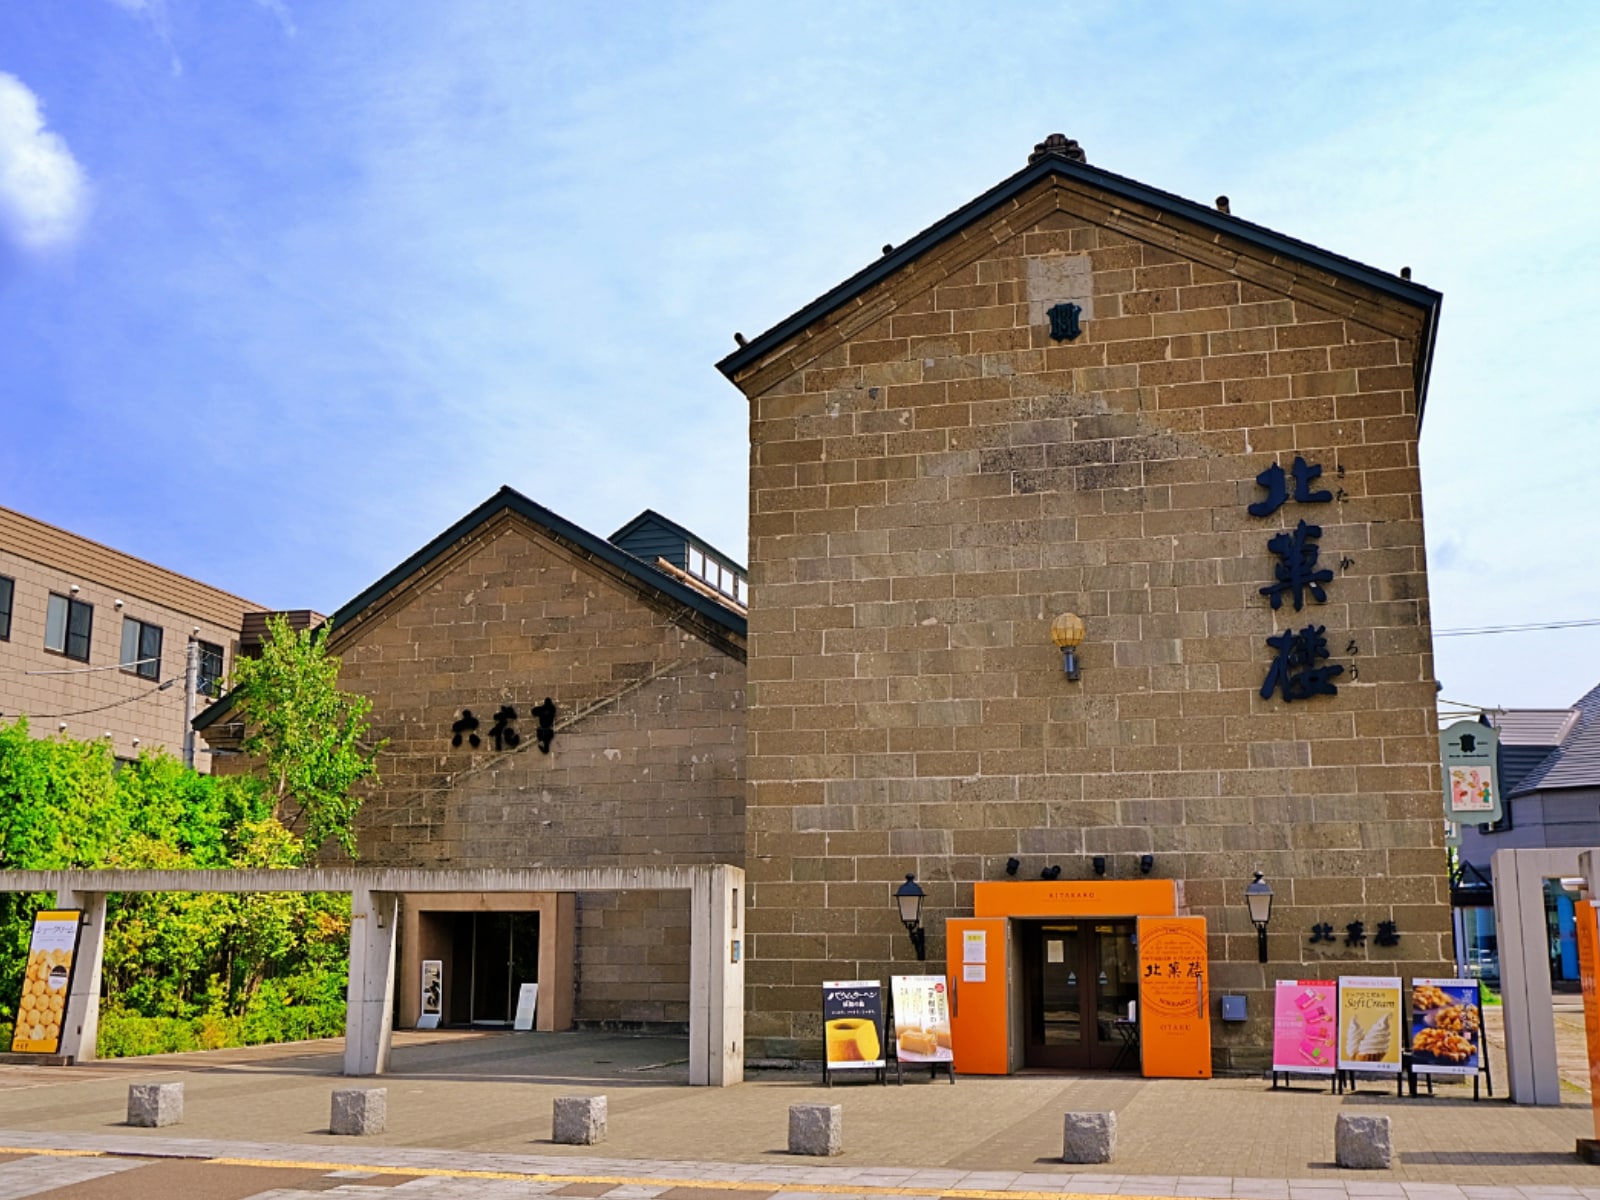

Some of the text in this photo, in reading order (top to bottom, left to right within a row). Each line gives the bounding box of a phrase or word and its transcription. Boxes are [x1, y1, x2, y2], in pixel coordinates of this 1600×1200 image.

[1336, 464, 1349, 504] きた
[1248, 456, 1344, 703] 北菓楼
